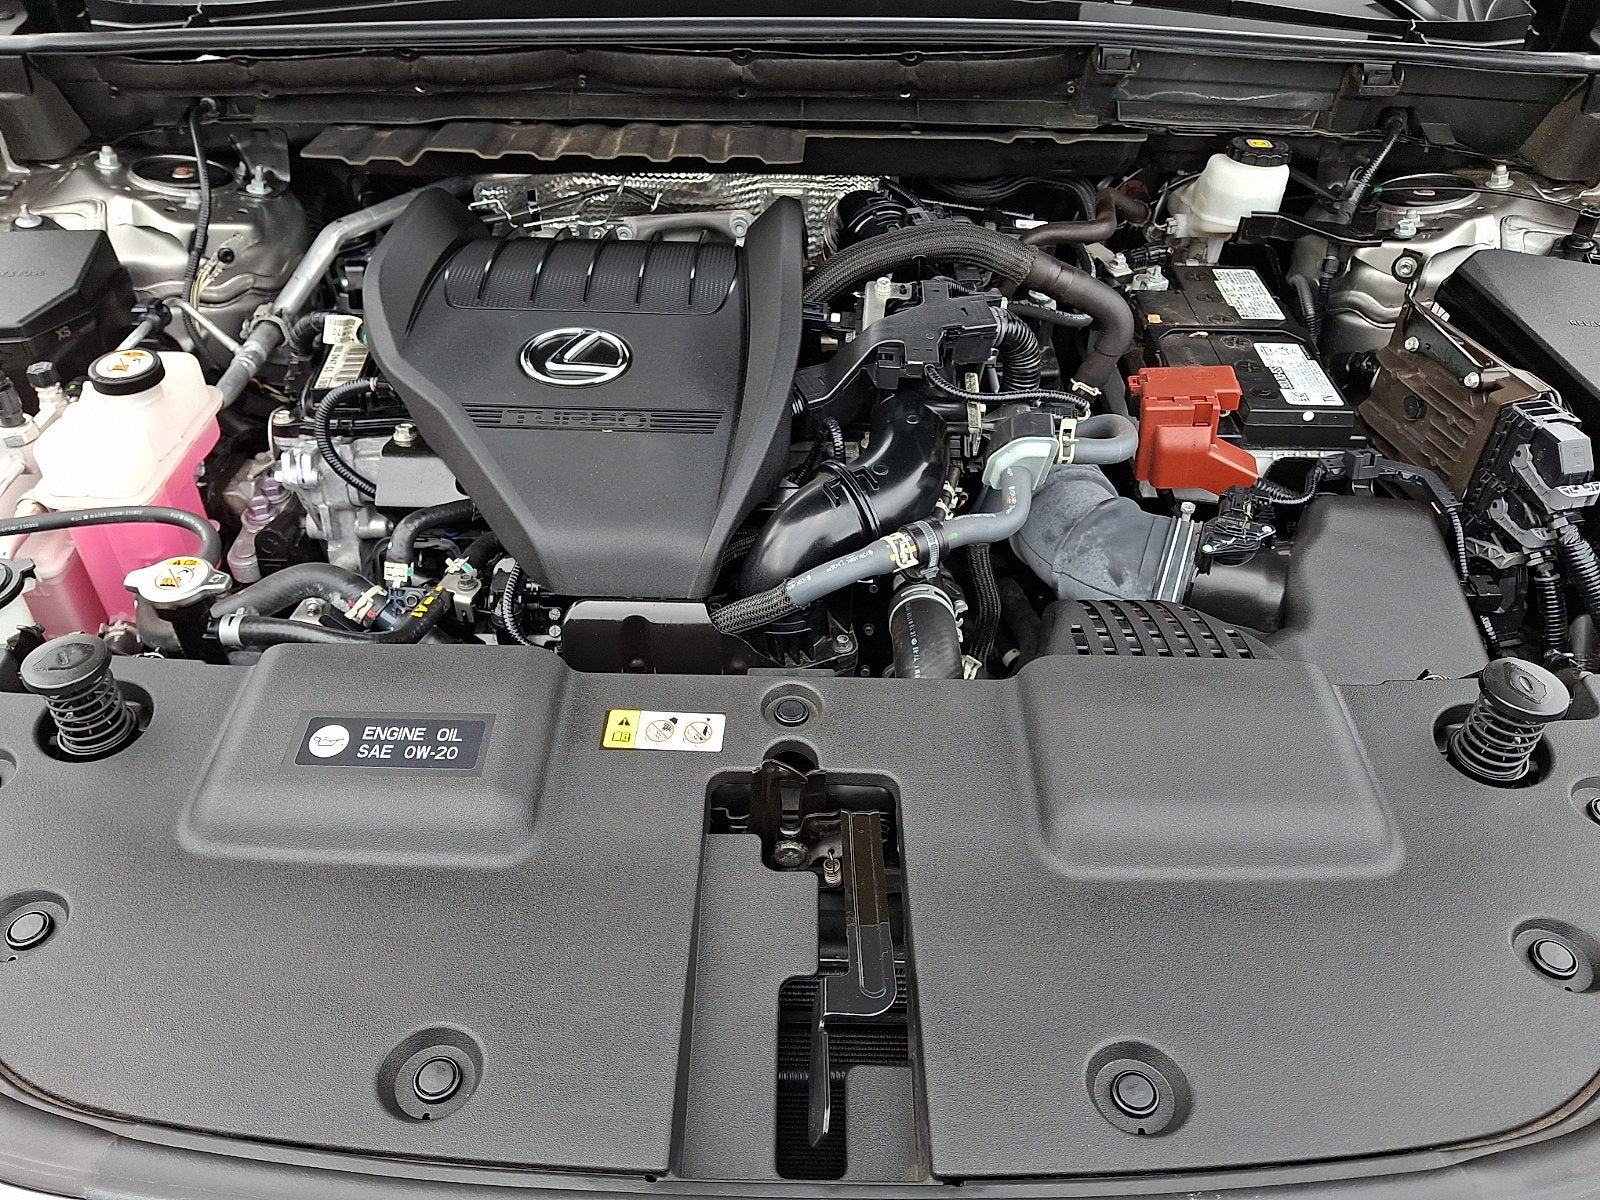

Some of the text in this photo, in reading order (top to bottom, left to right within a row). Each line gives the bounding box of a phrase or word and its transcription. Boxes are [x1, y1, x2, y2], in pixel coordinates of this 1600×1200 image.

[505, 409, 648, 428] TURBO
[361, 726, 463, 742] ENGINE OIL
[356, 744, 395, 759] SAE
